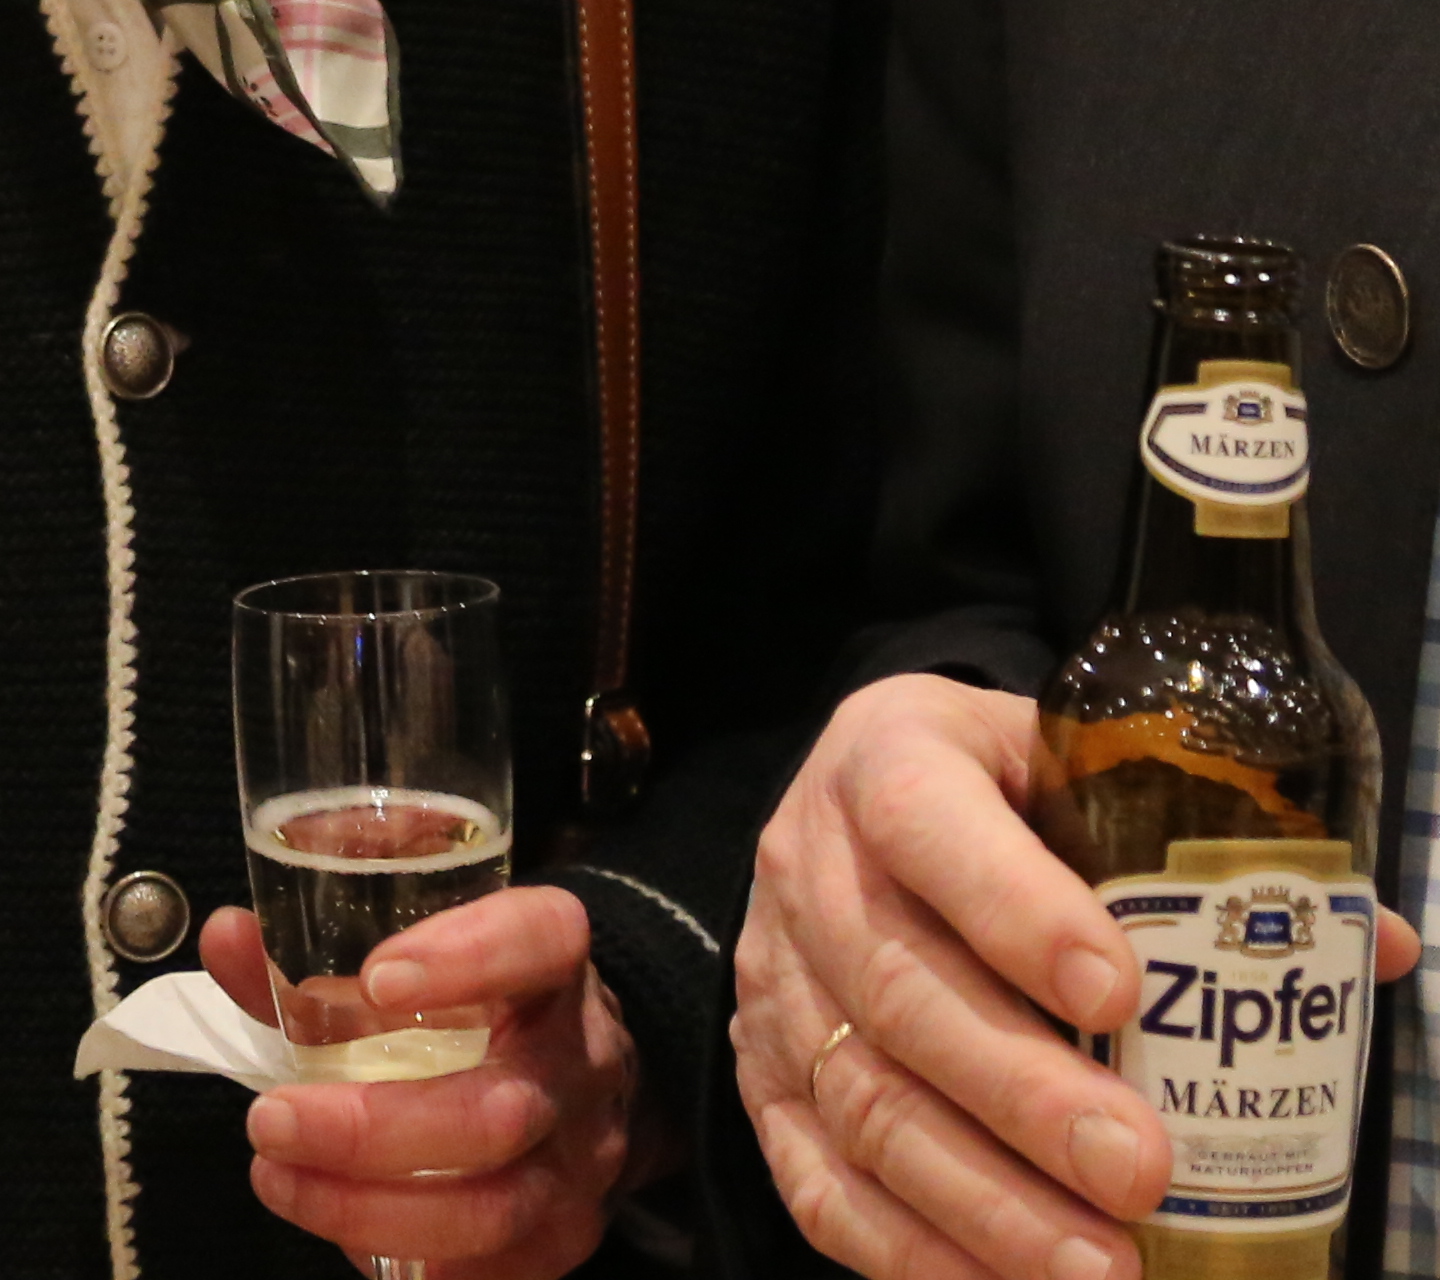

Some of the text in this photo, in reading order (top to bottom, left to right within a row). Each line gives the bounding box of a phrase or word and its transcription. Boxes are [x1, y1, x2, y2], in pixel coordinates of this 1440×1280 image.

[1191, 433, 1296, 458] MÄRZEN
[1140, 959, 1356, 1068] Zipfer
[1160, 1078, 1338, 1119] MÄRZEN
